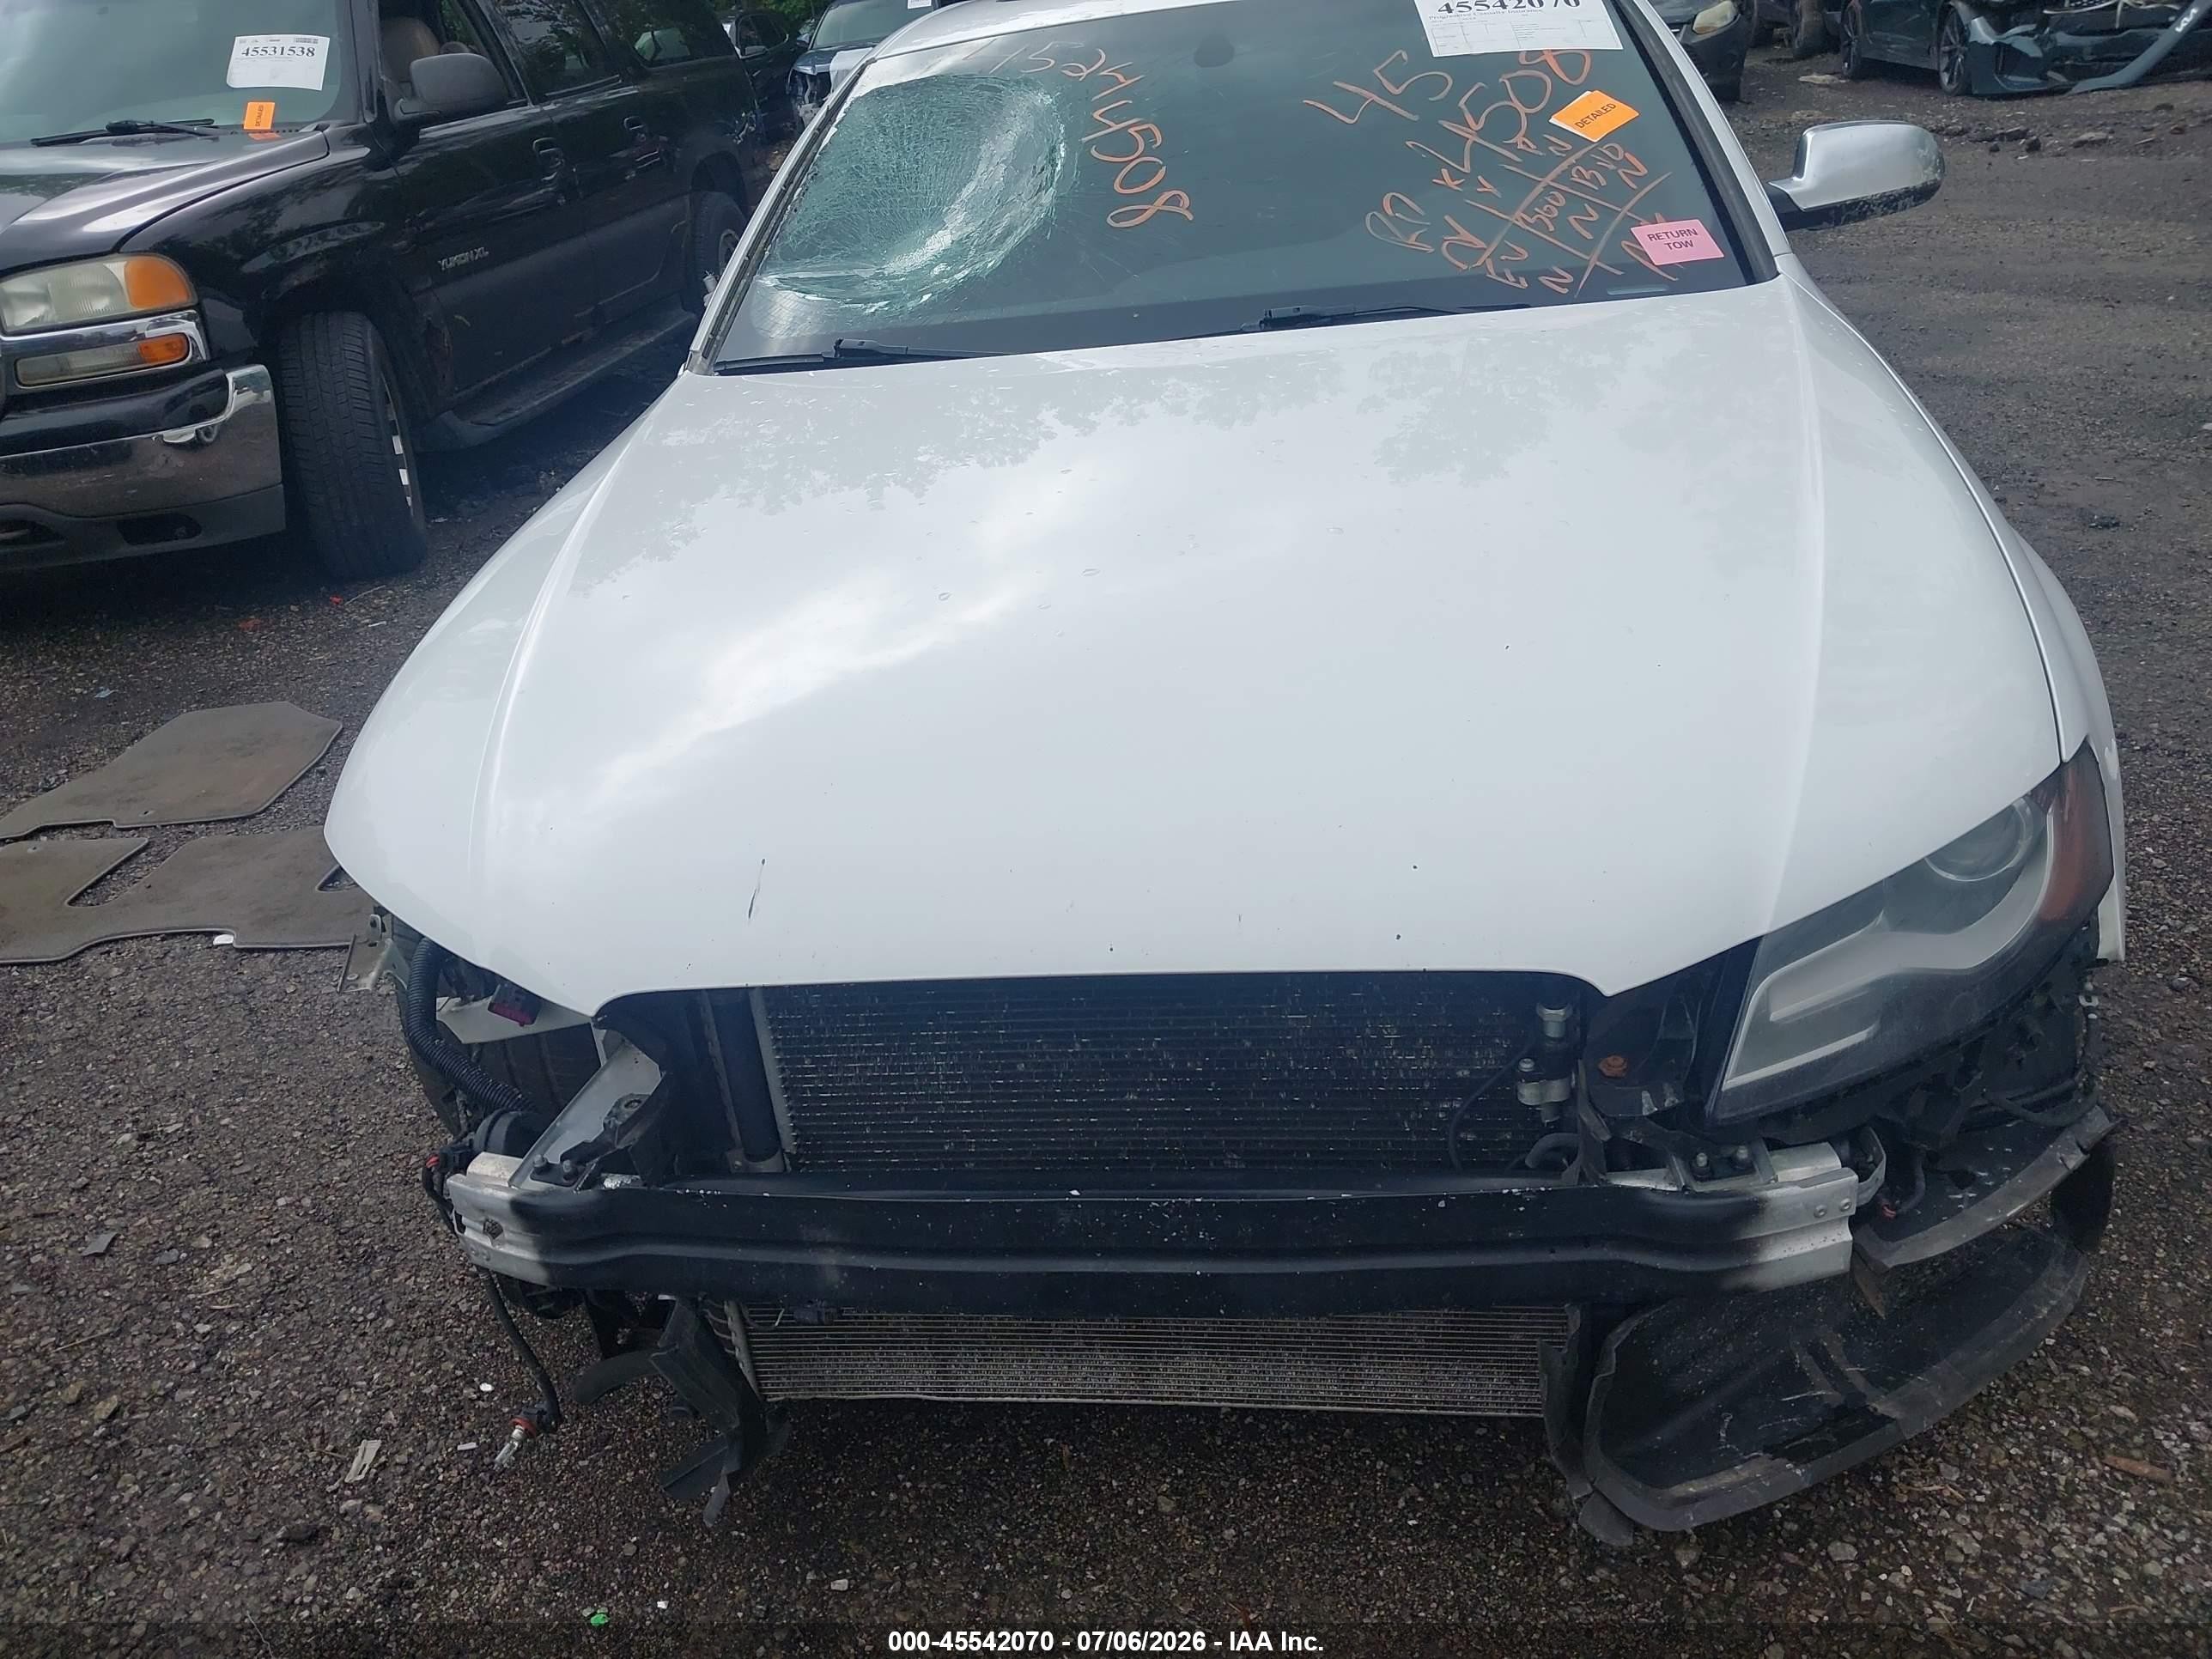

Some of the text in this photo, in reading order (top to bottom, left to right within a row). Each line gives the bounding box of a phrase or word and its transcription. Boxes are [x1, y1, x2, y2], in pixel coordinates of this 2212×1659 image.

[241, 46, 315, 58] 45531538
[1574, 102, 1618, 130] DETAILED
[1647, 227, 1698, 242] RETURN
[1663, 240, 1694, 251] TOW
